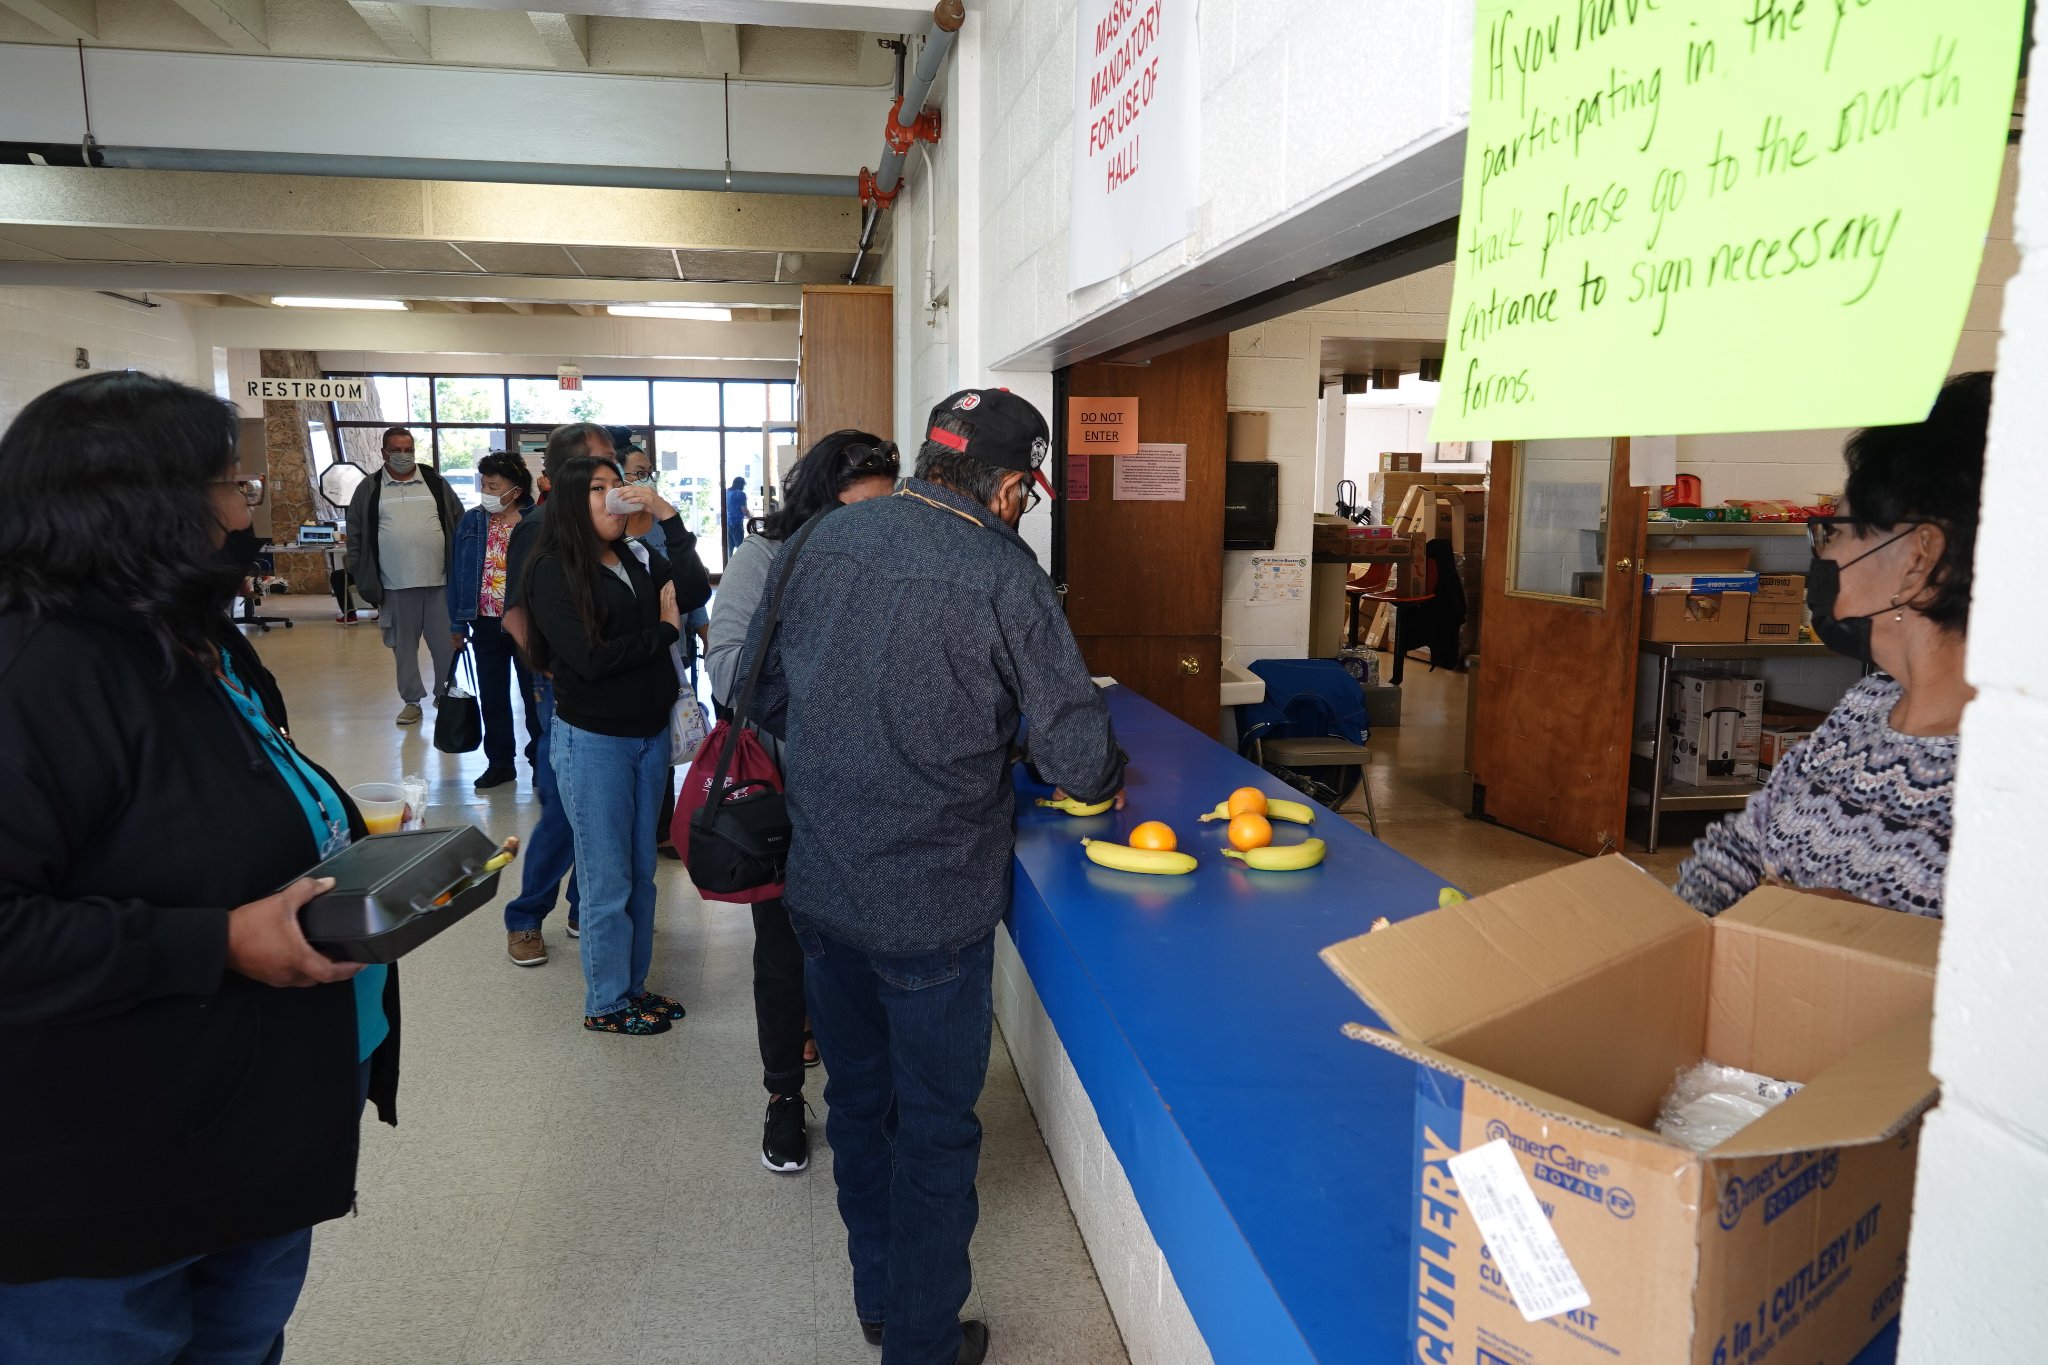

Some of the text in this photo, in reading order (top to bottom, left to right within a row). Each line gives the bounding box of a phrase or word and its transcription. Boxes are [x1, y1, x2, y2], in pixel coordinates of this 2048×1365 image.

[1089, 0, 1162, 110] MANDATORY
[1489, 9, 1513, 101] If
[1513, 15, 1560, 119] you
[1089, 56, 1160, 157] FOR USE OF
[1478, 67, 1661, 223] participating
[1107, 135, 1140, 195] HALL!
[1468, 207, 1524, 278] track
[1540, 182, 1629, 279] please
[1647, 168, 1687, 251] go
[1708, 129, 1739, 198] to
[1754, 115, 1818, 177] the
[1828, 33, 1960, 152] north
[1459, 207, 1903, 351] entrance to sign necessary
[247, 381, 362, 399] RESTROOM
[561, 376, 579, 390] EXIT
[1081, 412, 1124, 422] DO NOT
[1461, 358, 1536, 418] forms.
[1085, 430, 1119, 441] ENTER
[1535, 1165, 1603, 1203] ROYAL
[1417, 1125, 1460, 1365] CUTLERY
[1734, 1322, 1752, 1358] in
[1758, 1301, 1767, 1337] 1
[1772, 1228, 1850, 1324] CUTLERY
[1855, 1202, 1881, 1251] KIT
[1566, 1310, 1599, 1331] KIT
